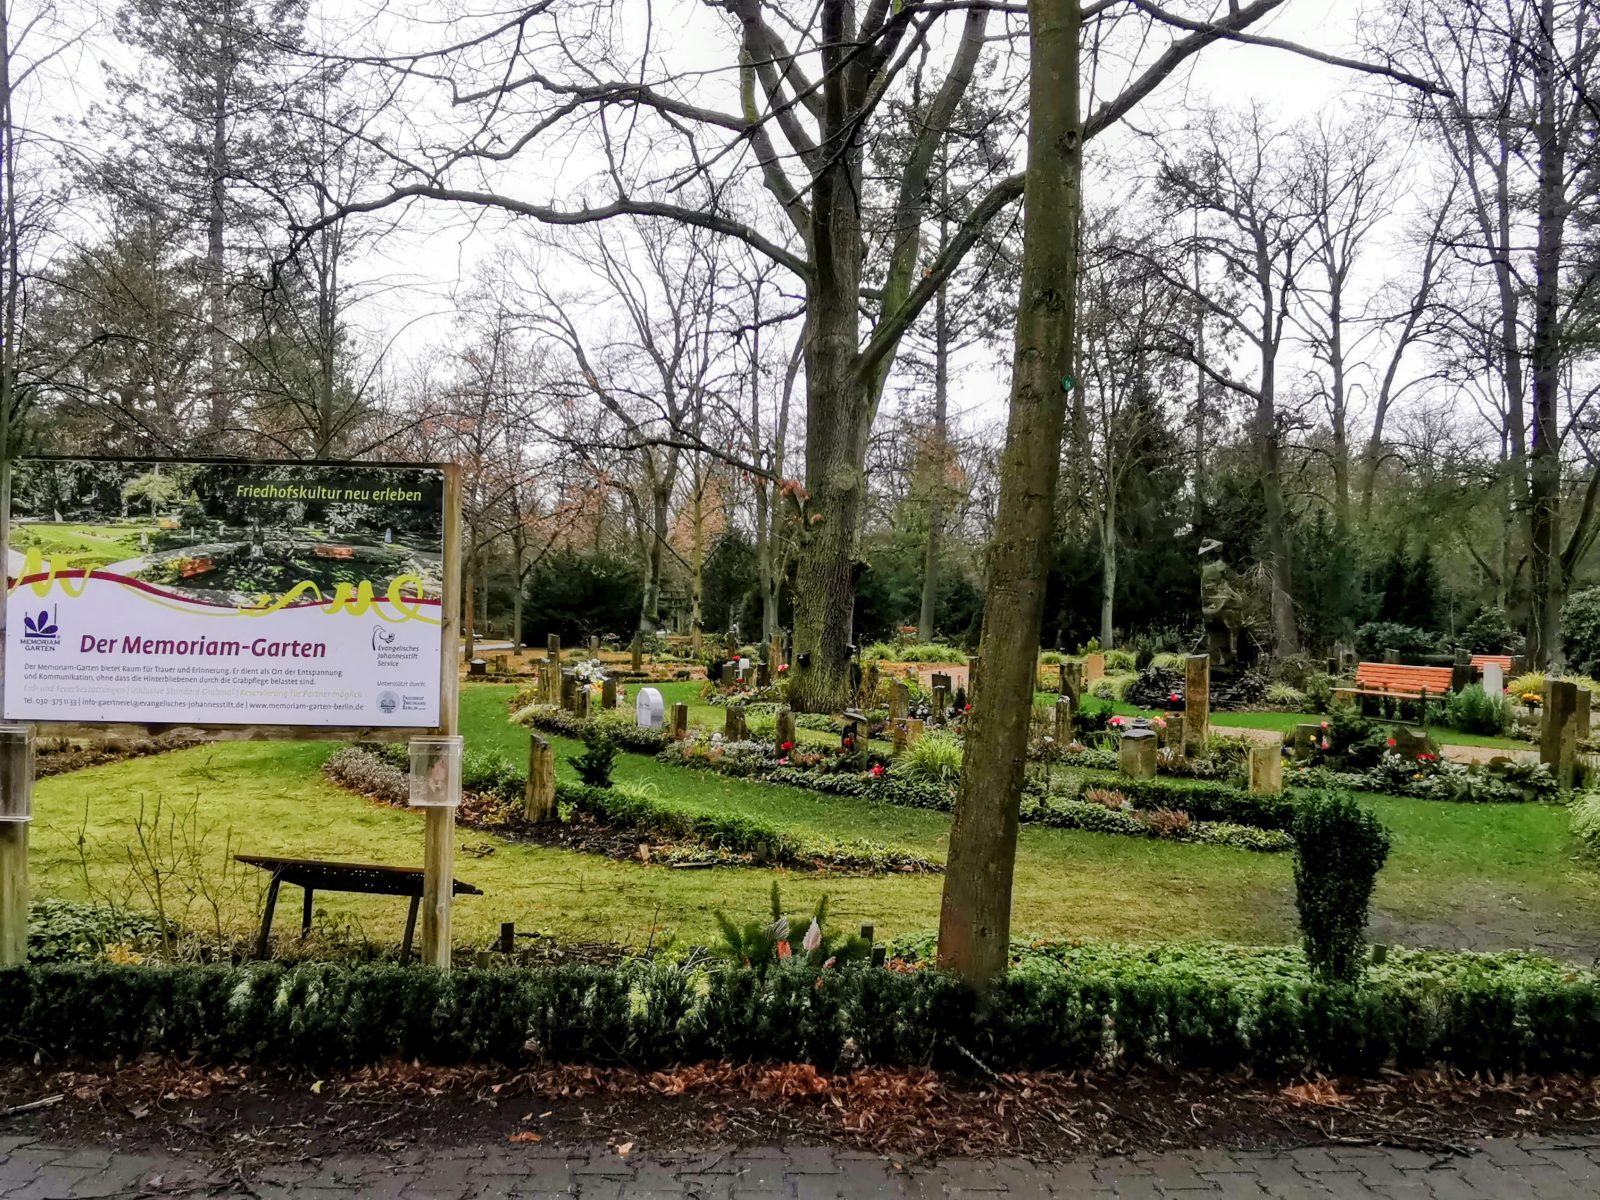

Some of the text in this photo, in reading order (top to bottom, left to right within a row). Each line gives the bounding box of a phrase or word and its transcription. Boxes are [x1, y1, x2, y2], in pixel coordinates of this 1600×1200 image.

[236, 484, 422, 502] Friedhofskultur neu erleben
[80, 634, 326, 658] Der Memoriam-Garten
[37, 663, 99, 671] Memoriam-Garten
[100, 664, 120, 672] bietet
[122, 665, 141, 673] Raum
[143, 665, 153, 673] für
[155, 665, 175, 673] Trauer
[192, 666, 231, 676] Erinnerung.
[232, 667, 239, 675] Er
[240, 667, 258, 675] dient
[284, 668, 295, 676] der
[297, 669, 343, 678] Entspannung
[38, 673, 95, 682] Kommunikation,
[143, 675, 197, 683] Hinterbliebenen
[199, 676, 218, 684] durch
[232, 677, 268, 686] Grabpflege
[270, 677, 297, 685] belastet
[249, 702, 364, 711] www.memoriam-garten-berlin.de
